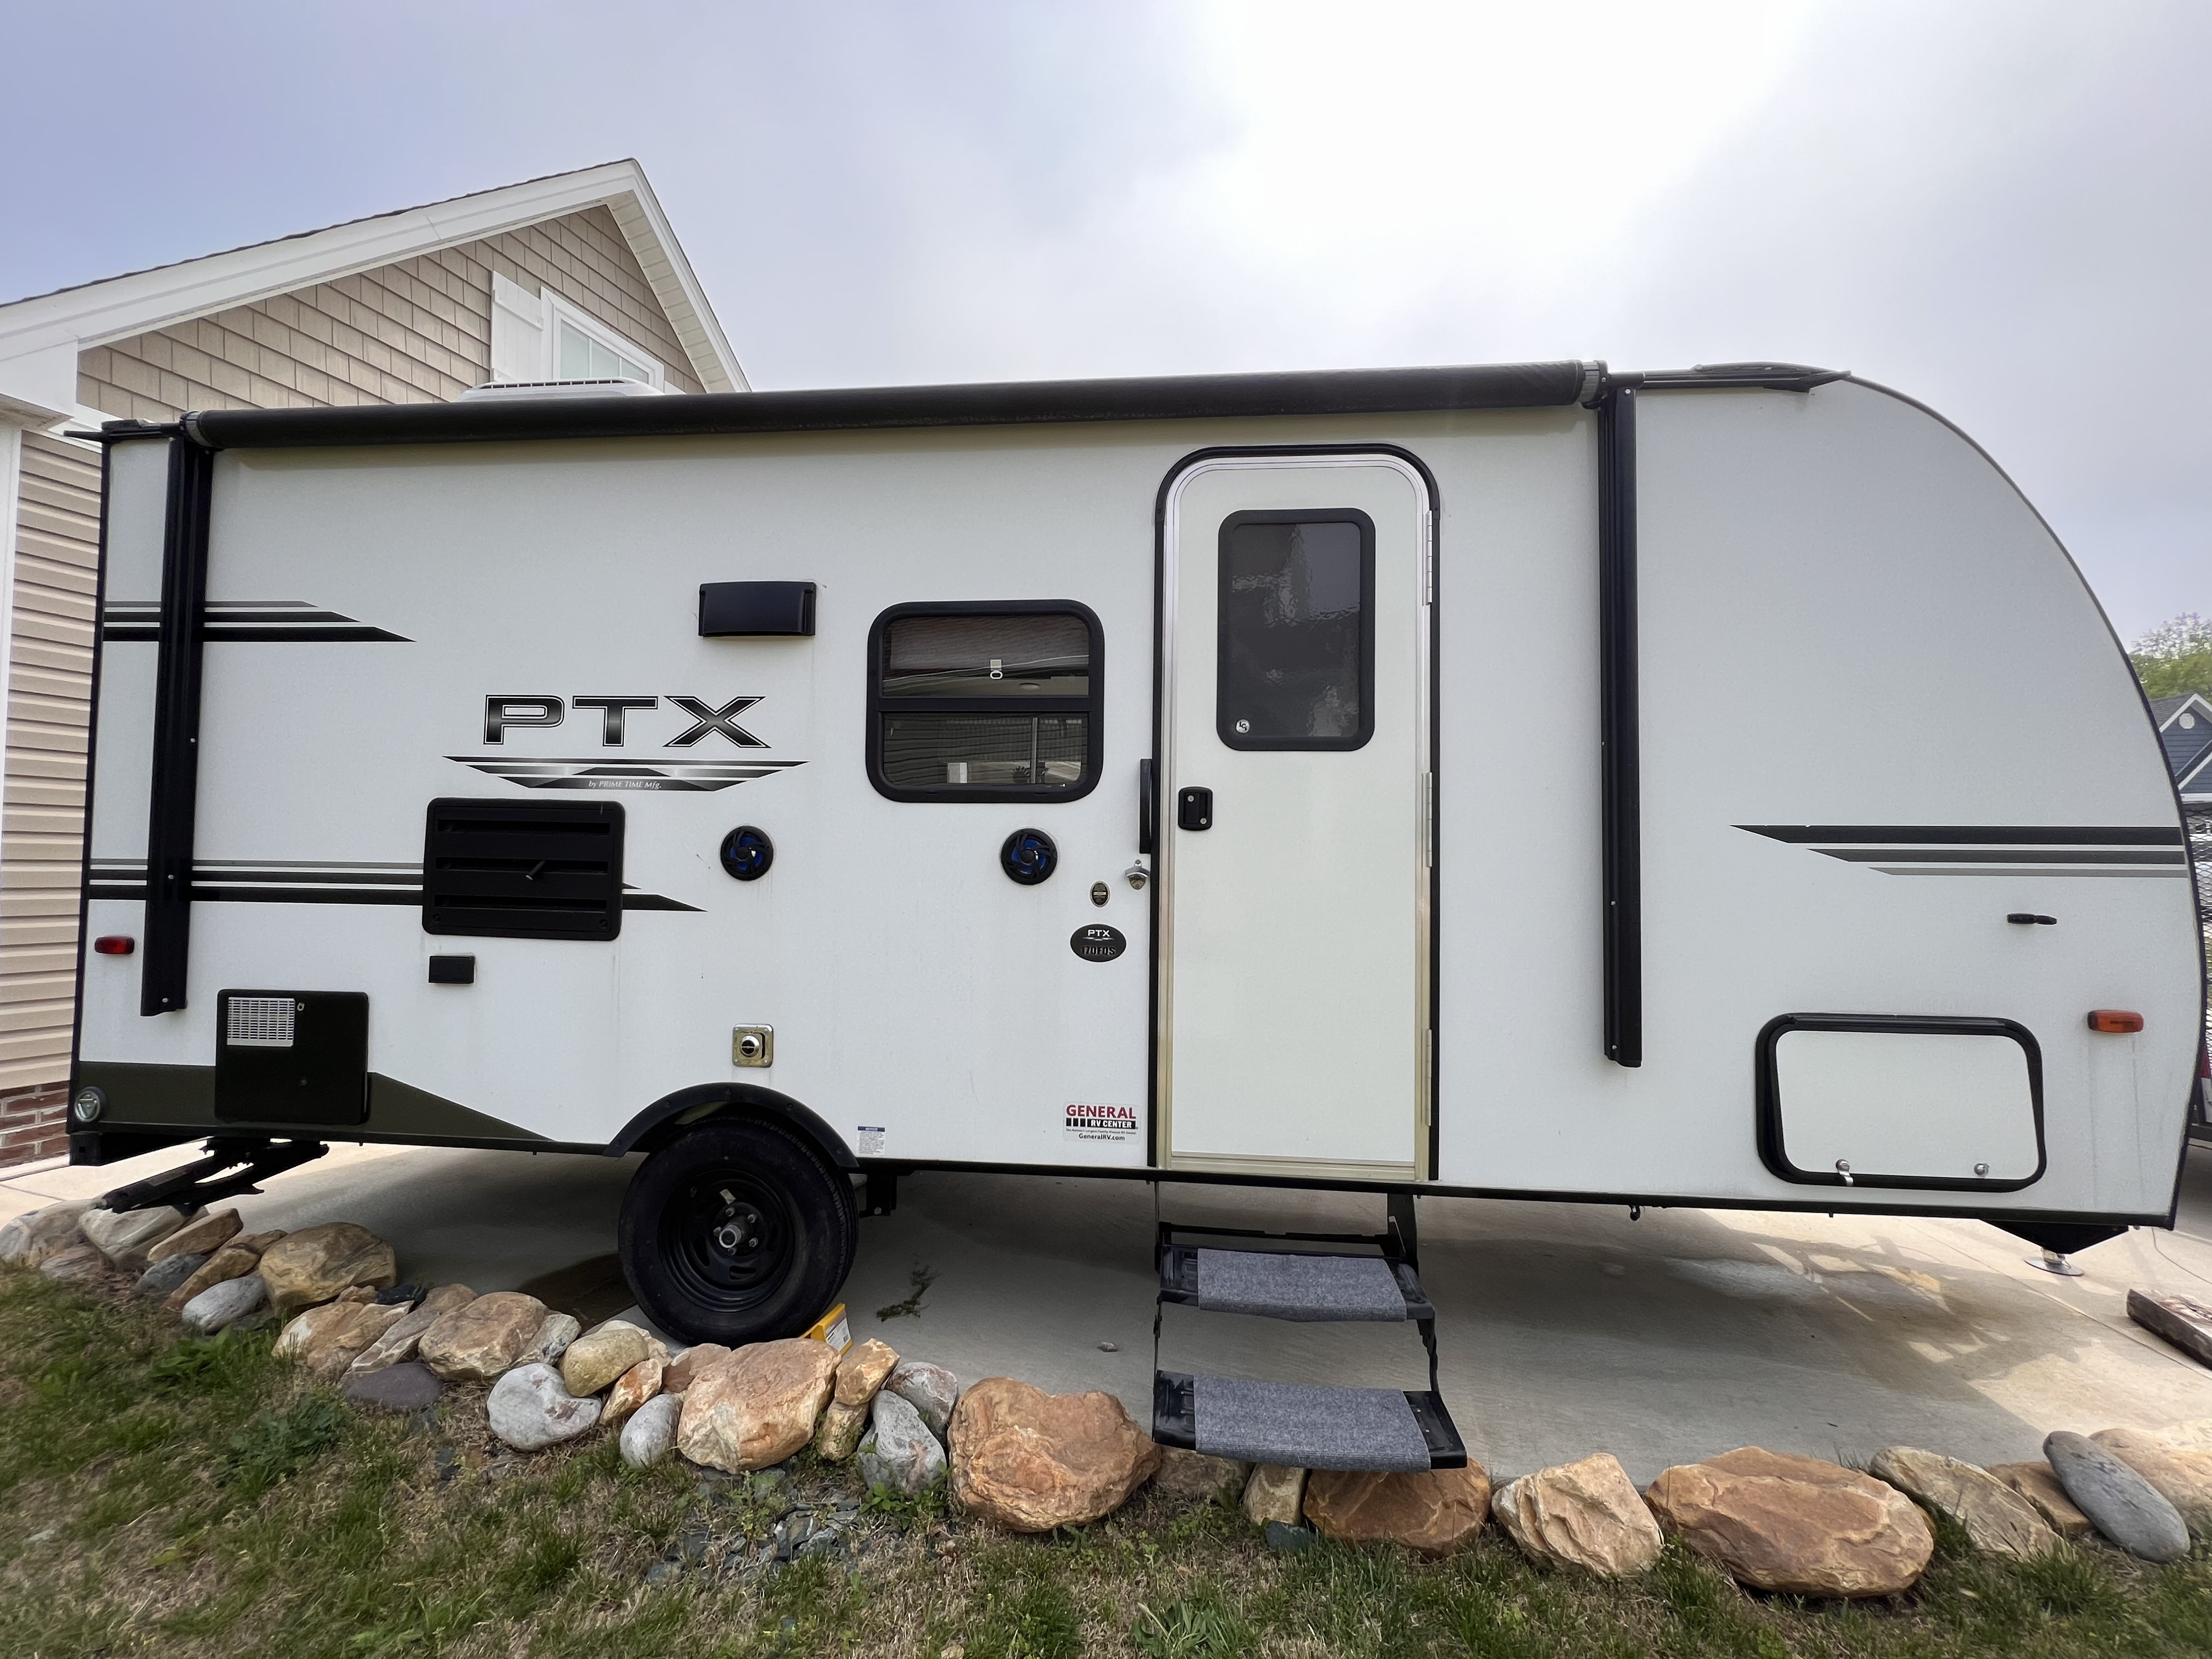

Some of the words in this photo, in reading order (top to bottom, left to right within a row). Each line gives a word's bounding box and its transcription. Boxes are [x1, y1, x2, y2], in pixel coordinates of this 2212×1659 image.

[483, 694, 772, 748] PTX
[588, 780, 597, 788] by
[644, 781, 662, 790] Mfg.
[1088, 929, 1110, 937] PTX
[1066, 1104, 1136, 1119] GENERAL
